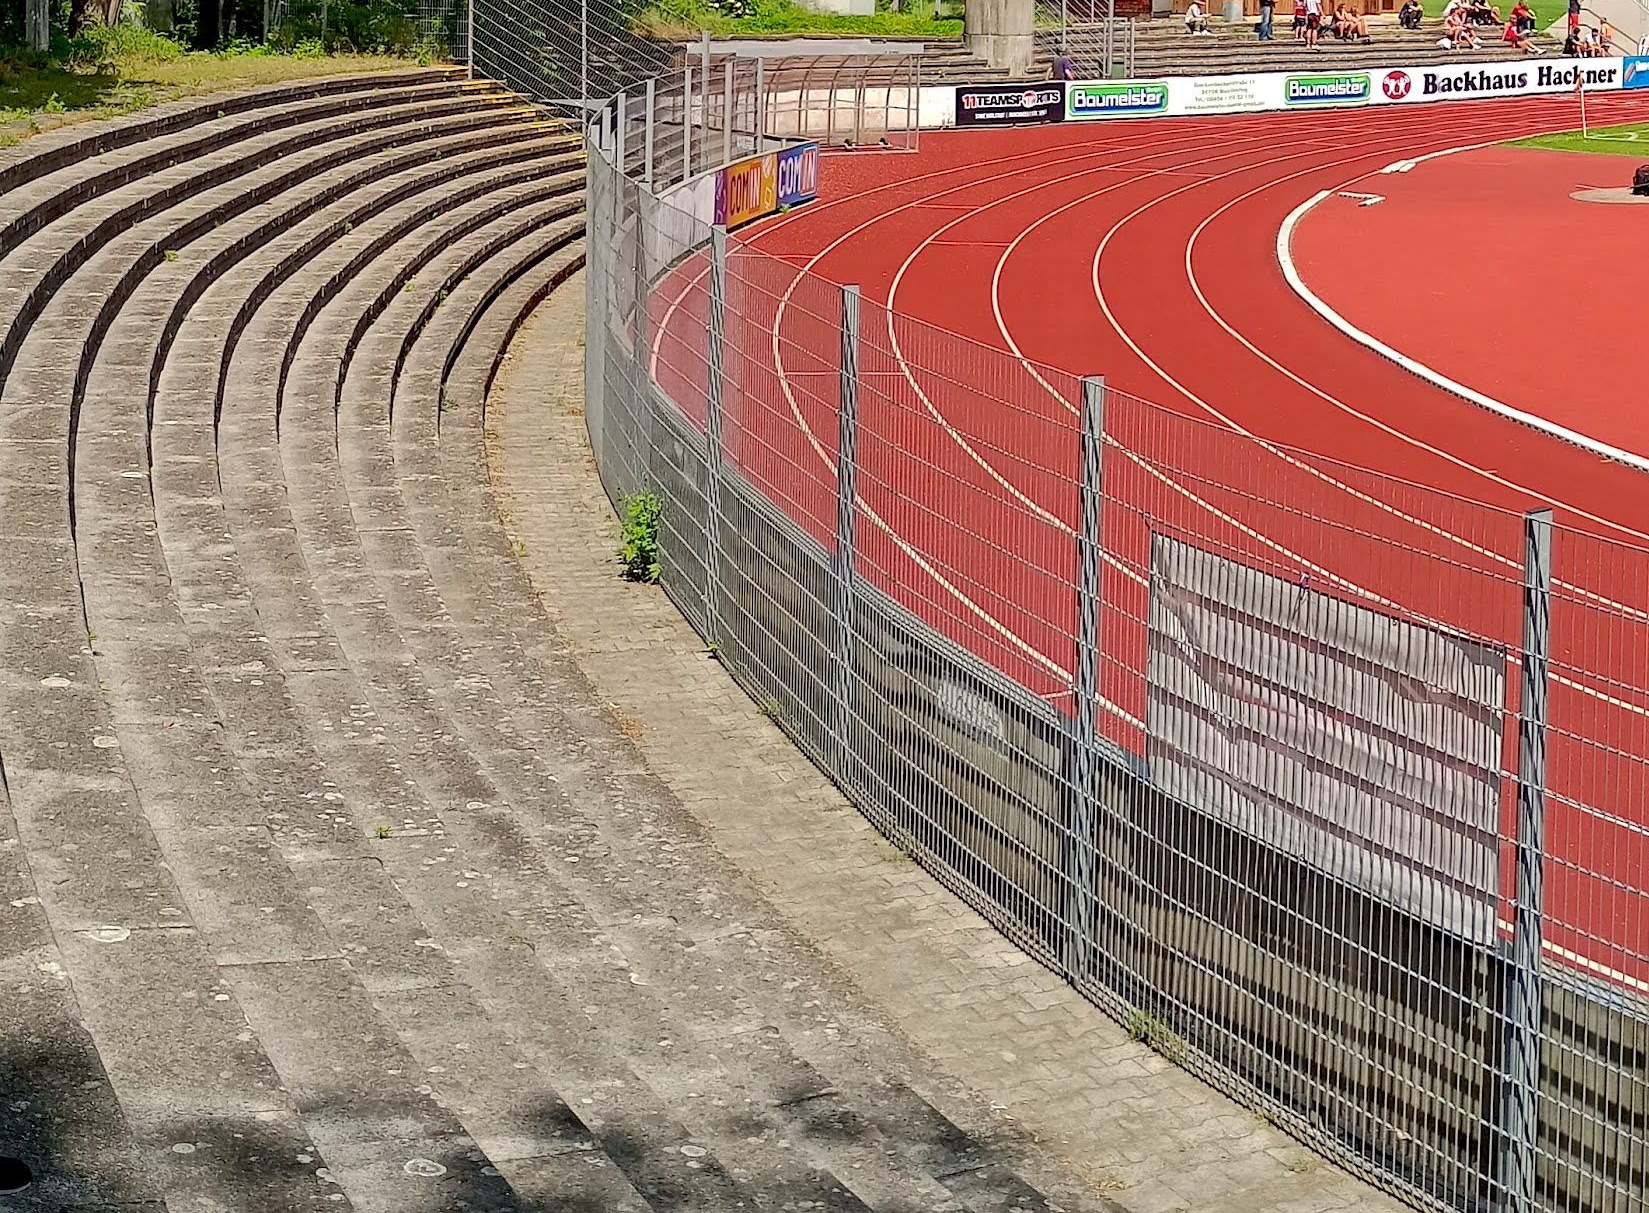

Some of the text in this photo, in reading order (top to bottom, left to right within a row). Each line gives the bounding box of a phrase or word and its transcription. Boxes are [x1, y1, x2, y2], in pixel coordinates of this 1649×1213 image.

[1422, 71, 1528, 95] Backhaus
[1537, 65, 1617, 87] Hackner
[730, 167, 761, 216] COMIN
[778, 149, 817, 199] COMIN
